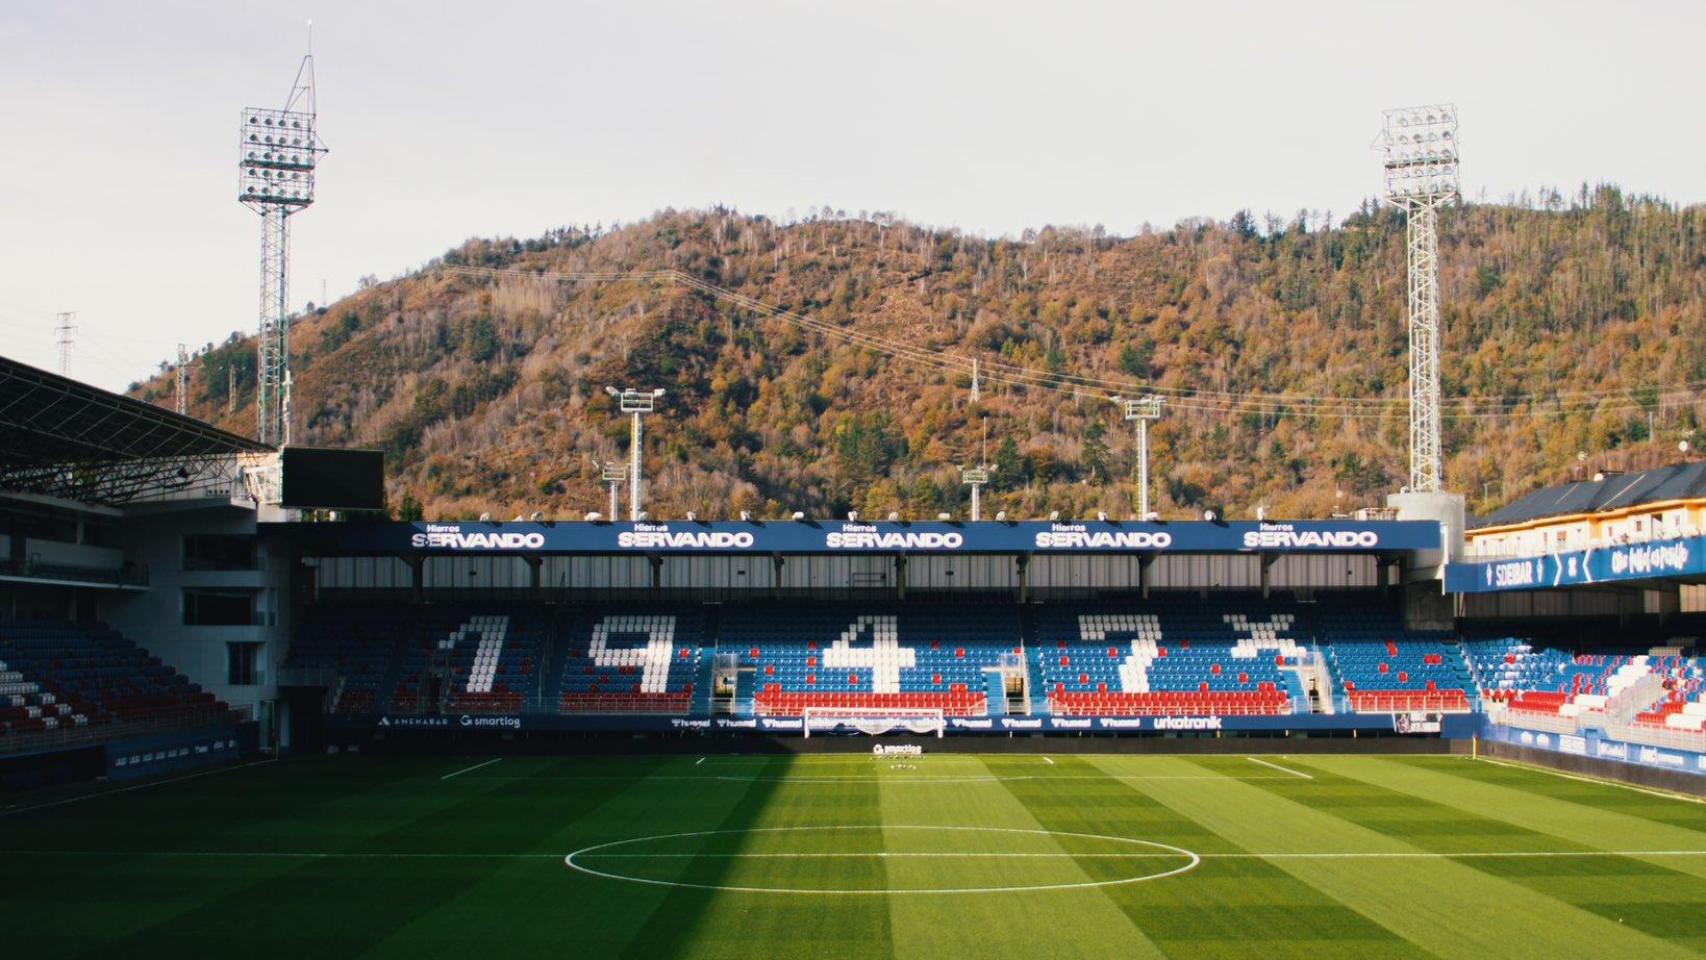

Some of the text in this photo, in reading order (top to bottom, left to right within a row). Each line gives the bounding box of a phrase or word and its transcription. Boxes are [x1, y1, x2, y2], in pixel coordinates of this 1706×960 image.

[411, 532, 545, 549] SERVANDO
[617, 532, 754, 549] SERVANDO
[826, 532, 963, 549] SERVANDO
[1035, 532, 1172, 549] SERVANDO
[1243, 532, 1378, 549] SERVANDO
[475, 716, 521, 728] smartlog
